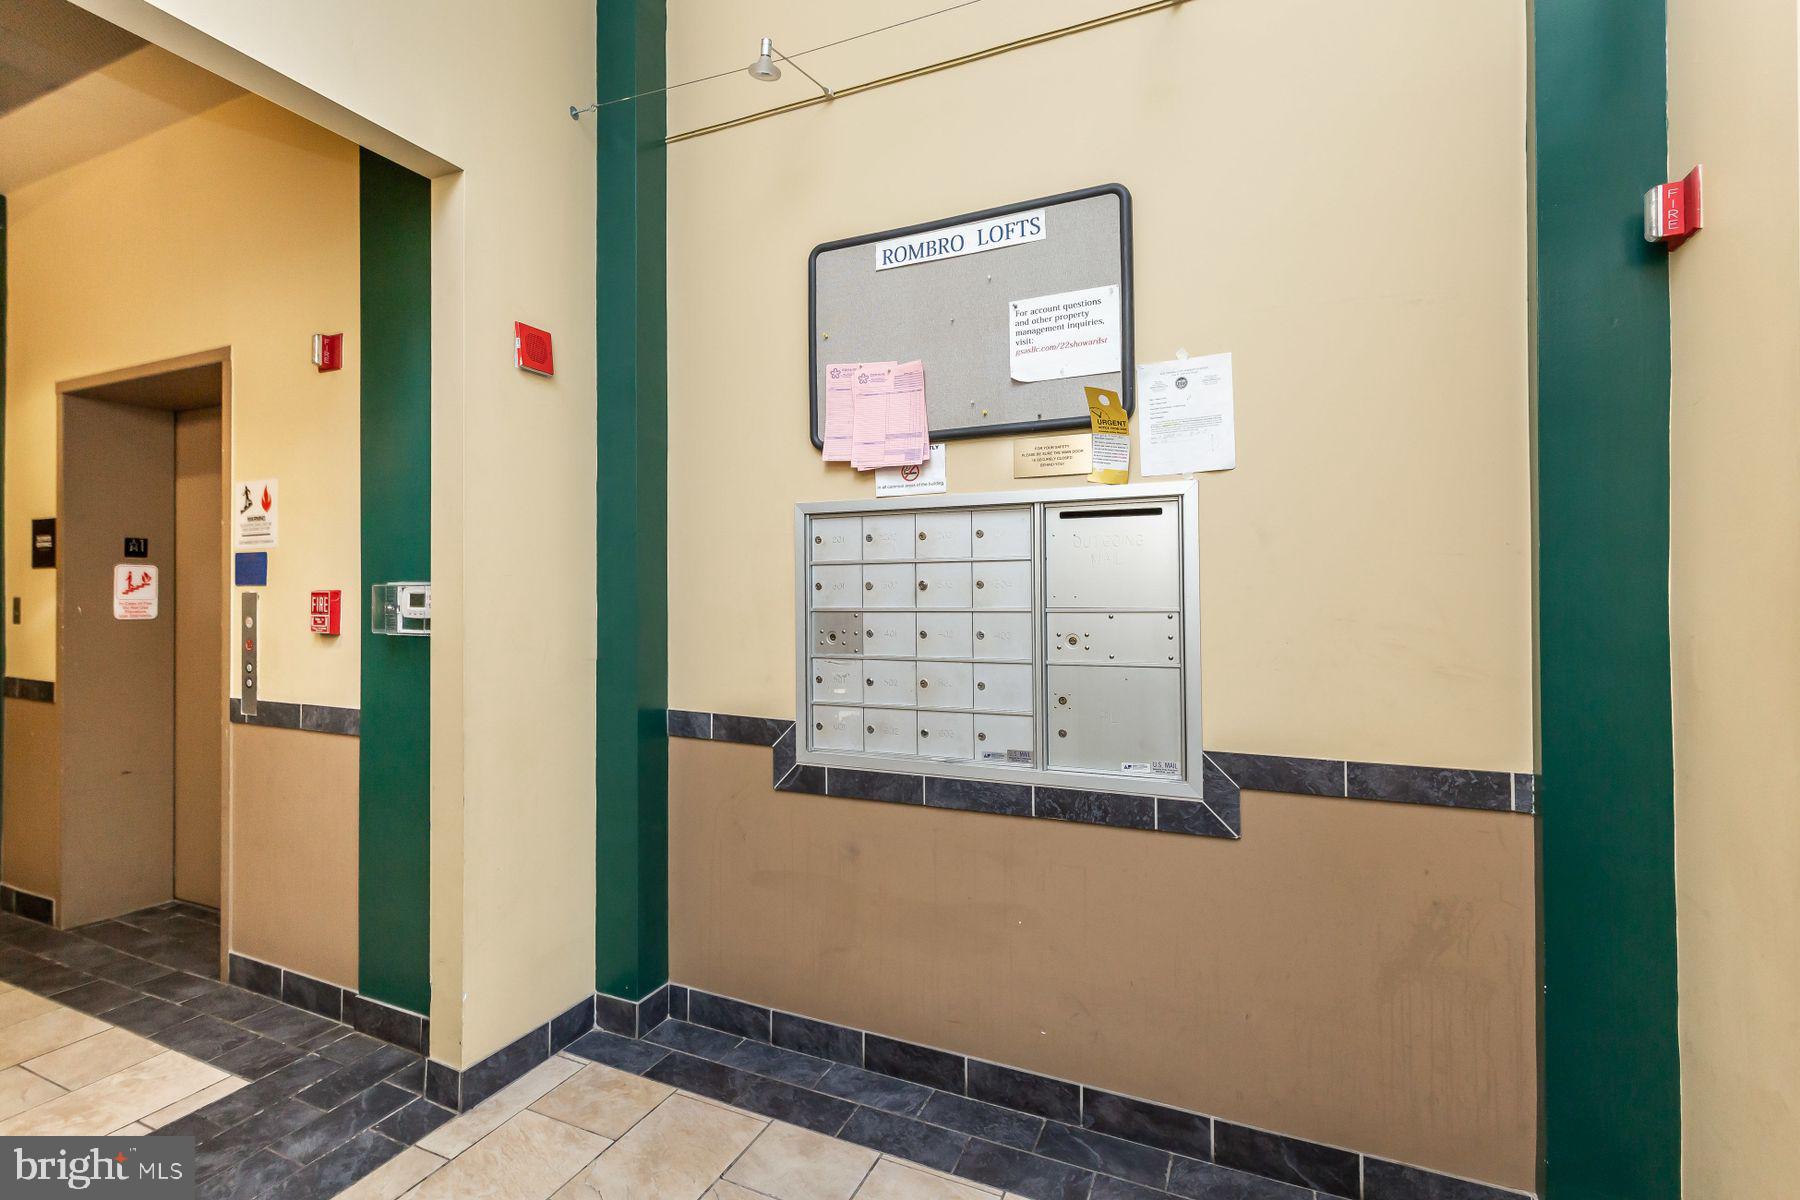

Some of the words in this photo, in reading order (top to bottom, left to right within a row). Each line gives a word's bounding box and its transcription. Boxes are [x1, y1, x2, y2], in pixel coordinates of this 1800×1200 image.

[1667, 187, 1680, 230] FIRE
[882, 234, 965, 265] ROMBRO
[977, 216, 1041, 246] LOFTS
[1015, 309, 1028, 318] For
[1030, 304, 1060, 315] account
[1062, 298, 1102, 312] questions
[1015, 317, 1029, 327] and
[1031, 314, 1053, 325] other
[1054, 309, 1090, 323] property
[1015, 323, 1065, 337] management
[1015, 338, 1034, 347] visit:
[1097, 419, 1126, 428] URGENT
[312, 596, 328, 613] FIRE
[1164, 762, 1178, 770] MAIL
